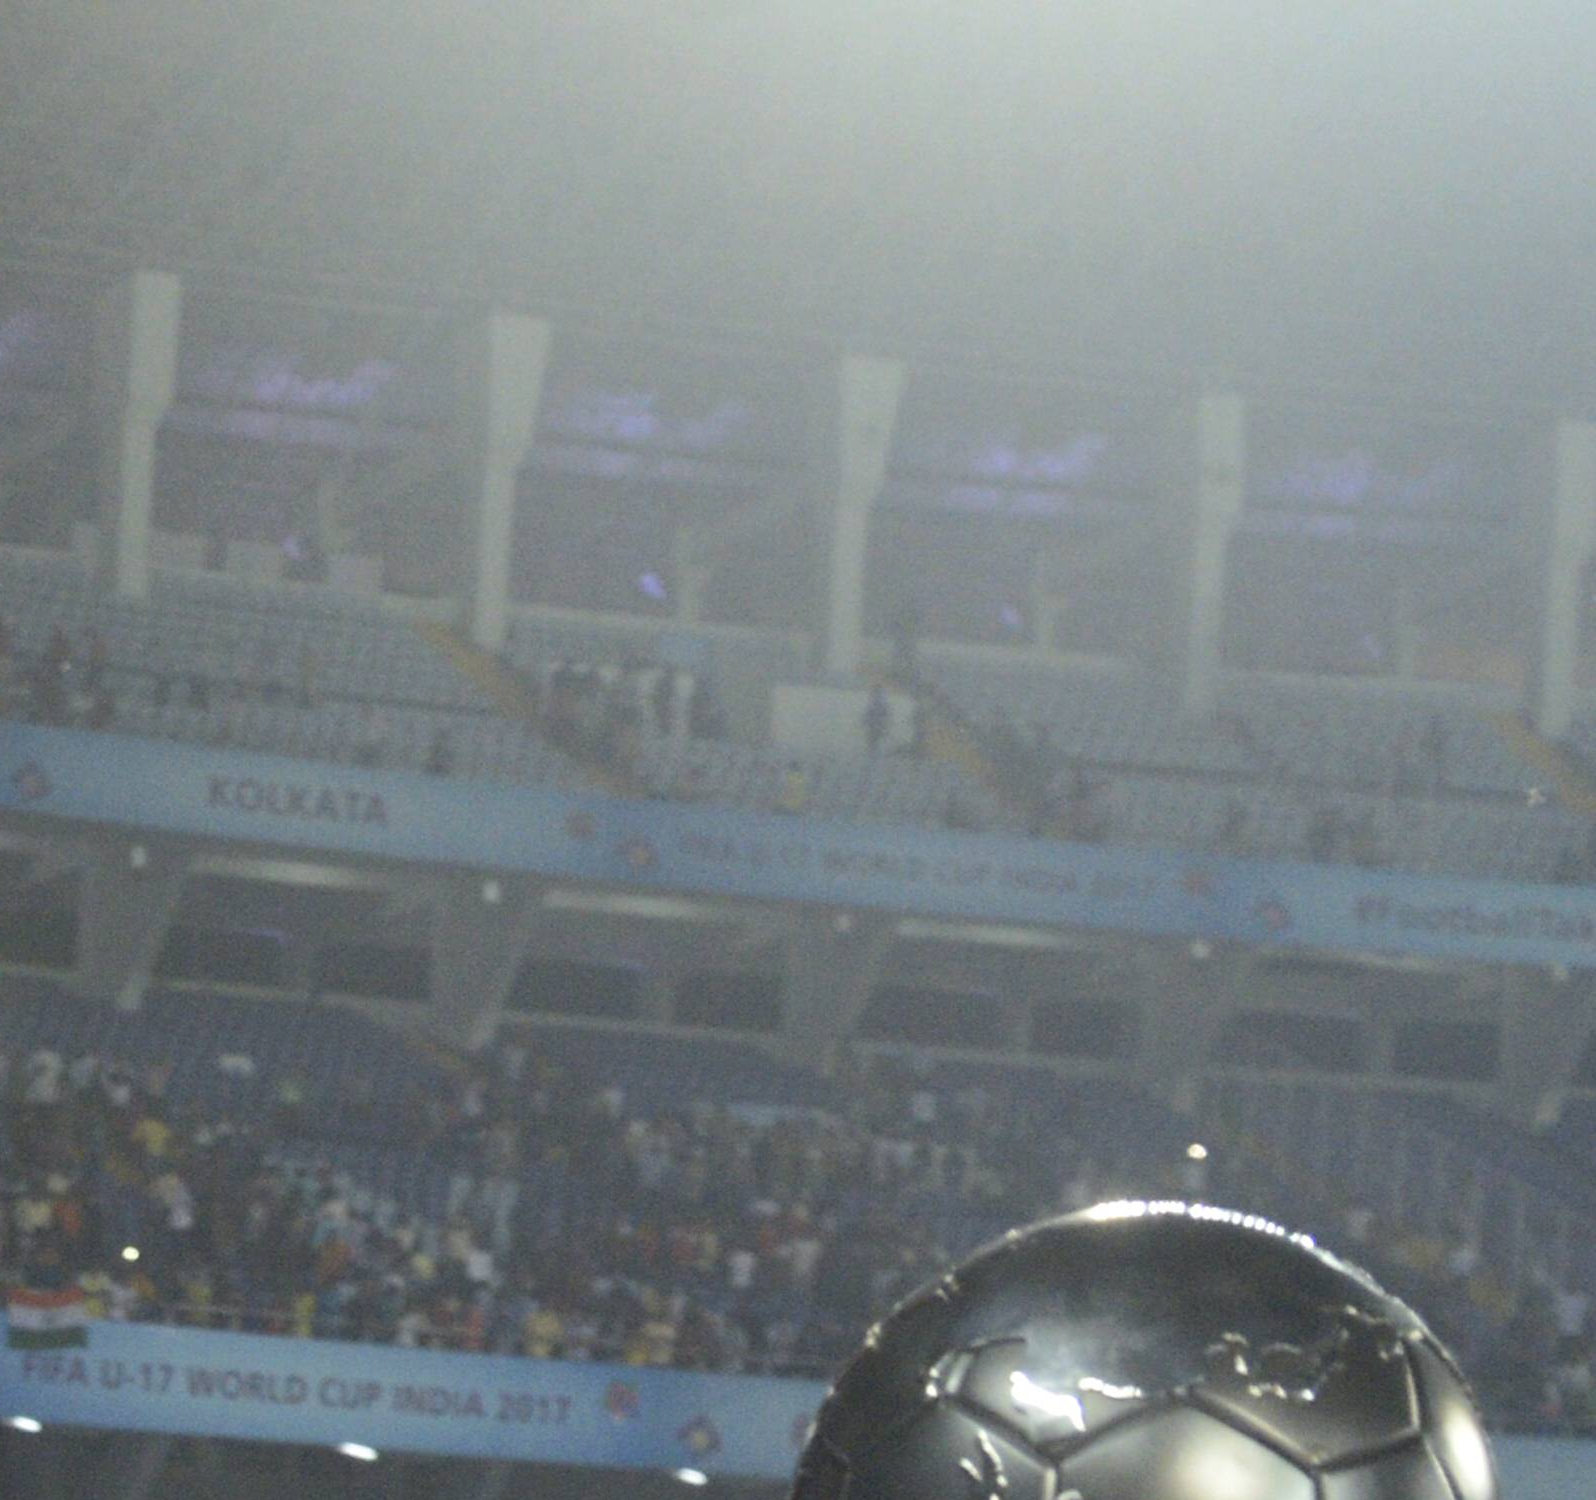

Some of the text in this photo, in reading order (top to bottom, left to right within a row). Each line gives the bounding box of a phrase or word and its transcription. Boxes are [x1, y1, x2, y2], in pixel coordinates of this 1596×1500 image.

[206, 773, 389, 828] KOLKATA
[23, 1350, 88, 1387] FIFA
[99, 1358, 174, 1394] U-17
[186, 1366, 309, 1405] WORLD
[317, 1375, 382, 1410] CUP
[391, 1384, 485, 1417] INDIA
